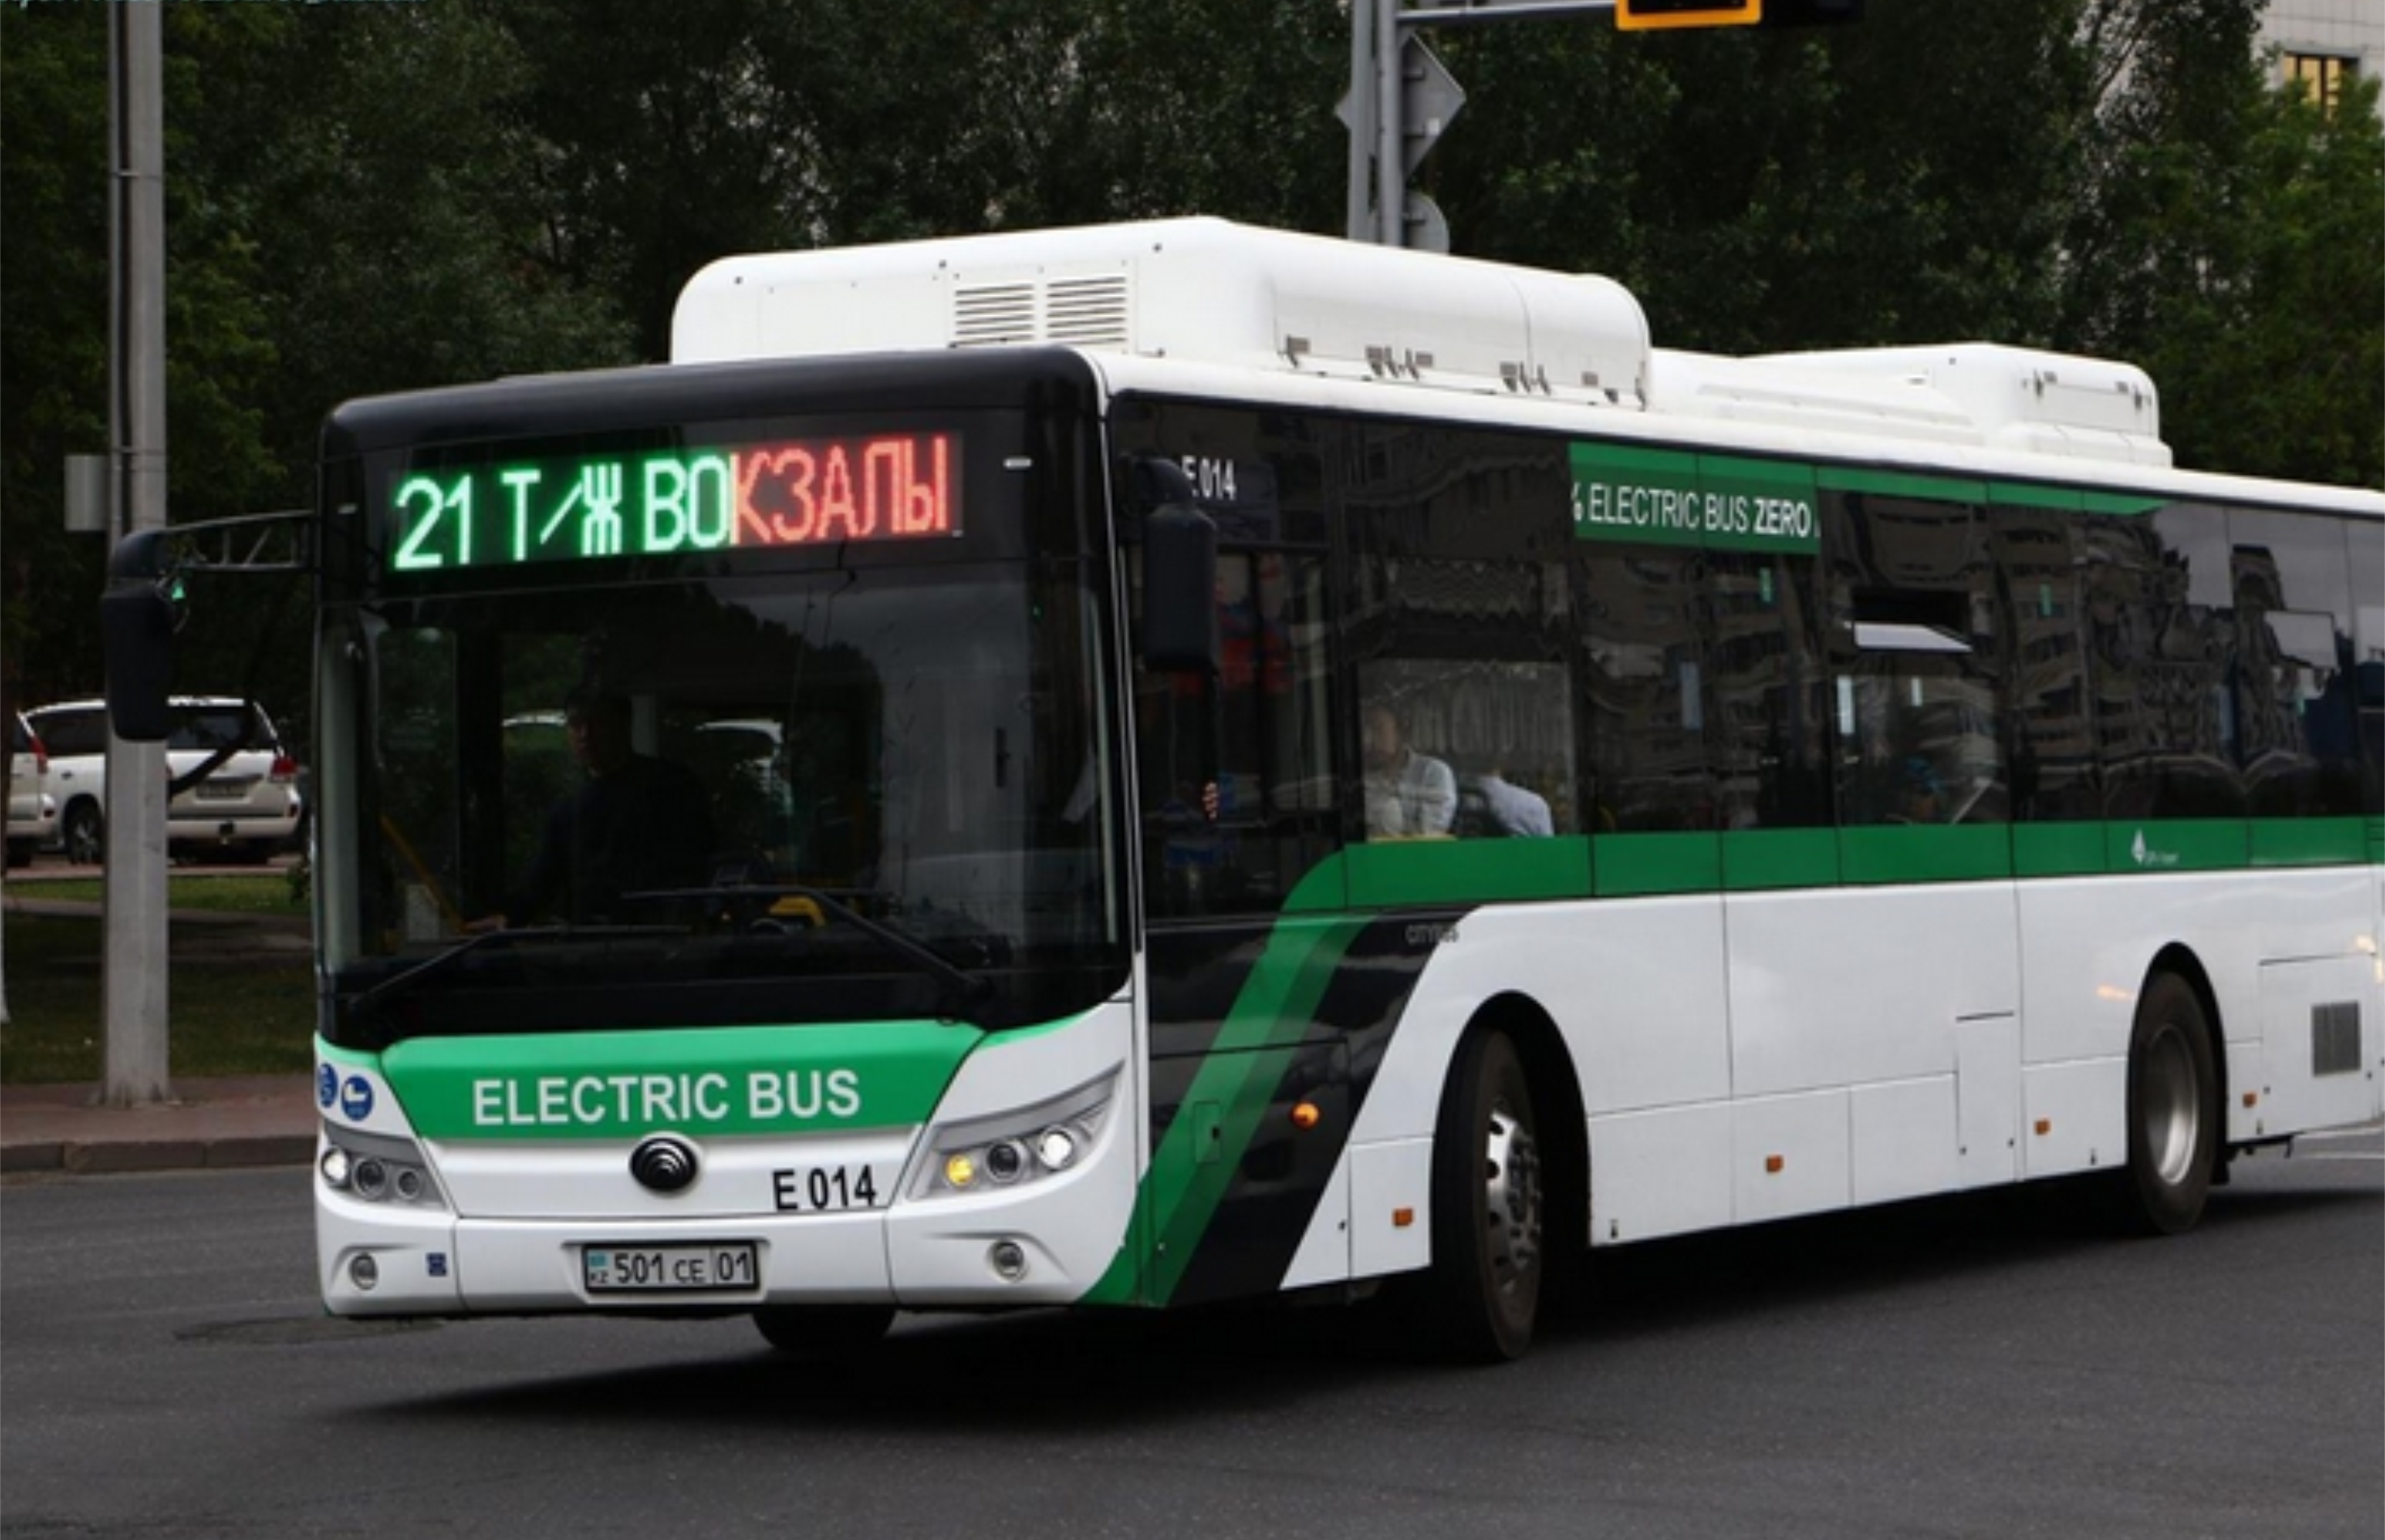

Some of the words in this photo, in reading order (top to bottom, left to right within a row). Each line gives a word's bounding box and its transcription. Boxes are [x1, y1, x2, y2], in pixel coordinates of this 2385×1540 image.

[500, 464, 622, 561] Т/Ж
[644, 437, 947, 552] ВОКЗАЛЫ
[1200, 457, 1237, 500] 014
[396, 474, 471, 569] 21
[1589, 482, 1700, 530] ELECTRIC
[1705, 493, 1749, 533] BUS
[1753, 495, 1812, 538] ZERO
[473, 1073, 729, 1125] ELECTRIC
[747, 1063, 861, 1119] BUS
[773, 1168, 798, 1210] E
[808, 1164, 877, 1209] 014
[614, 1252, 664, 1283] 501
[674, 1259, 706, 1283] CE
[718, 1251, 751, 1281] 01
